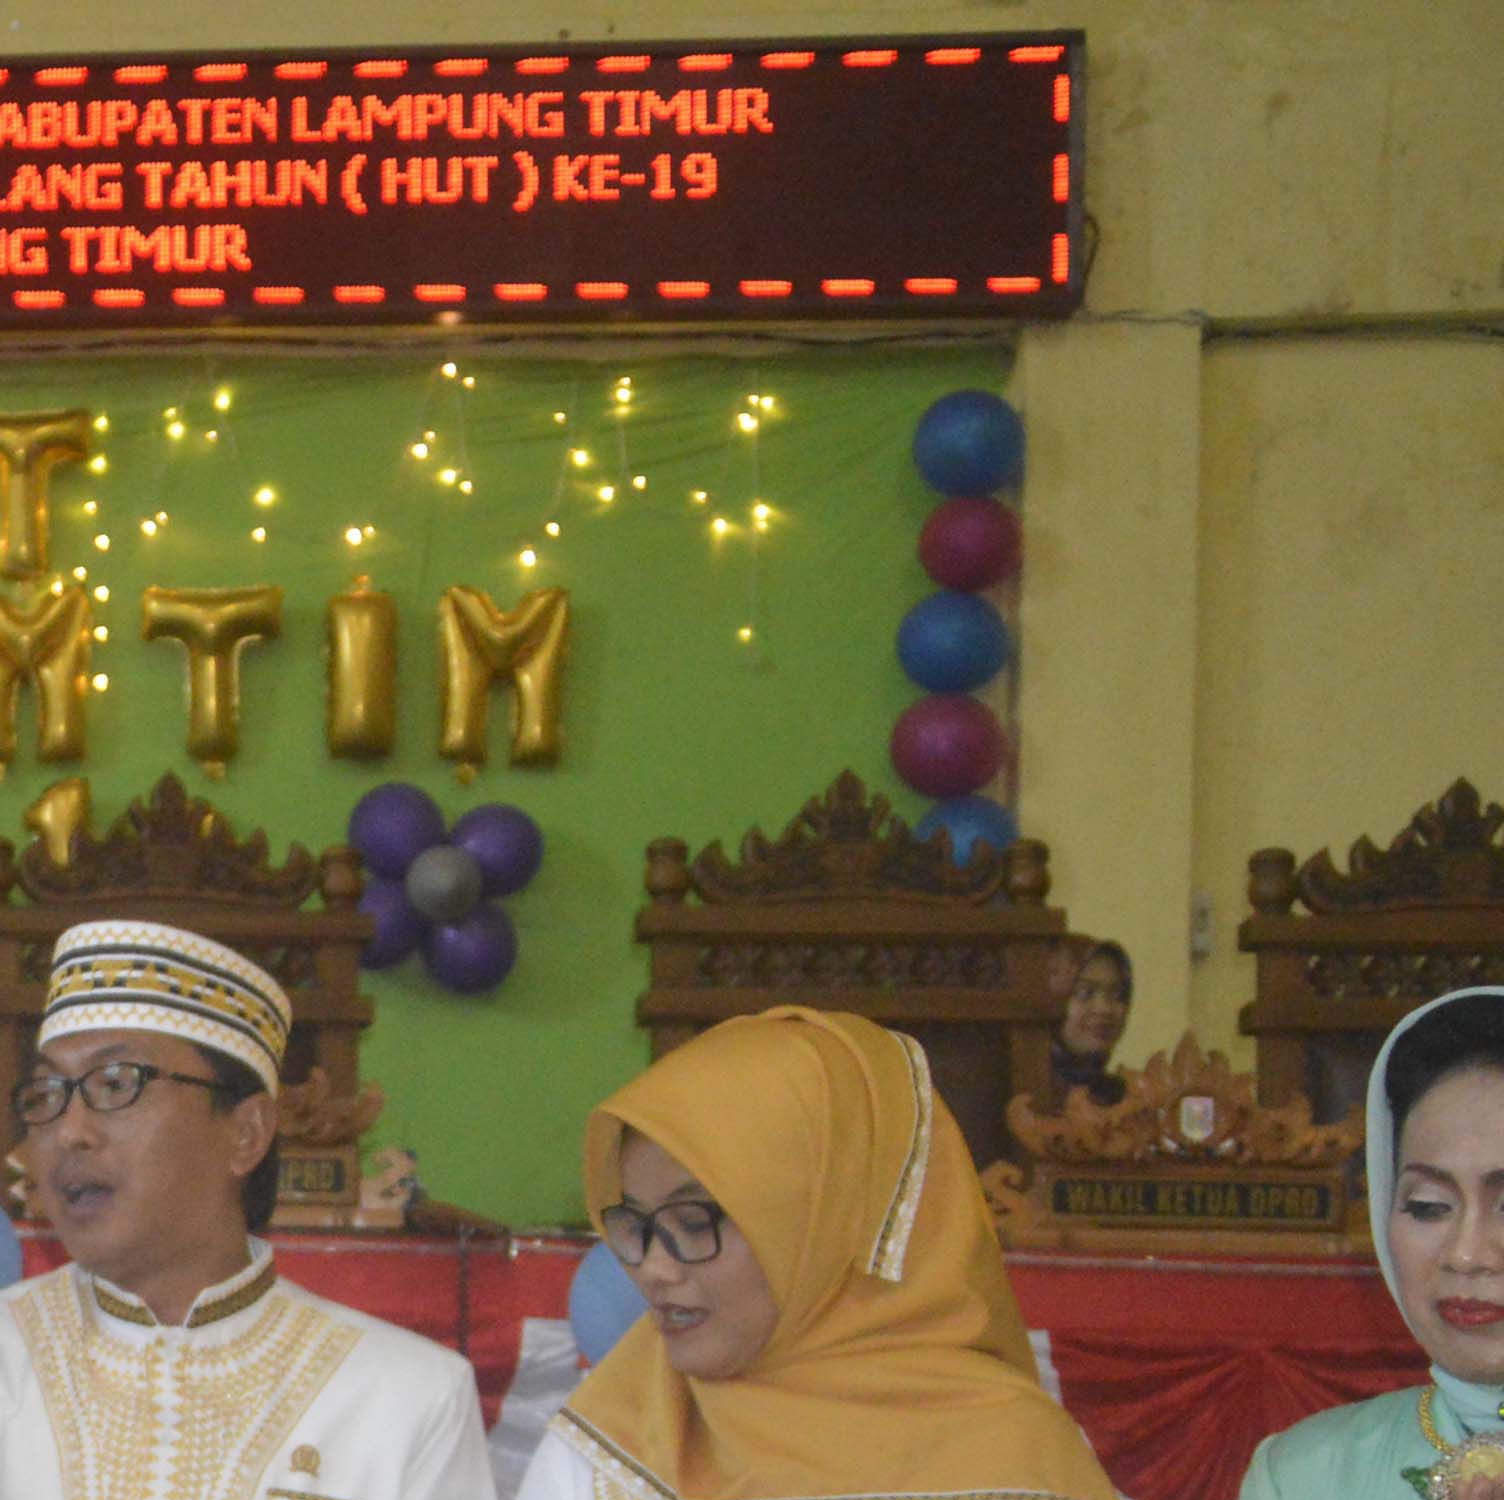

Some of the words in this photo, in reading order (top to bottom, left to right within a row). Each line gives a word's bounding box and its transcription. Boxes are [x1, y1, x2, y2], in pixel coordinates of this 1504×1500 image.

[290, 91, 565, 143] LAMPUNG
[578, 87, 773, 137] TIMUR
[134, 158, 328, 210] TAHUN
[552, 152, 717, 202] KE-19
[59, 223, 252, 275] TIMUR
[1066, 1182, 1145, 1212] WAKIL
[1156, 1183, 1241, 1215] KETUA
